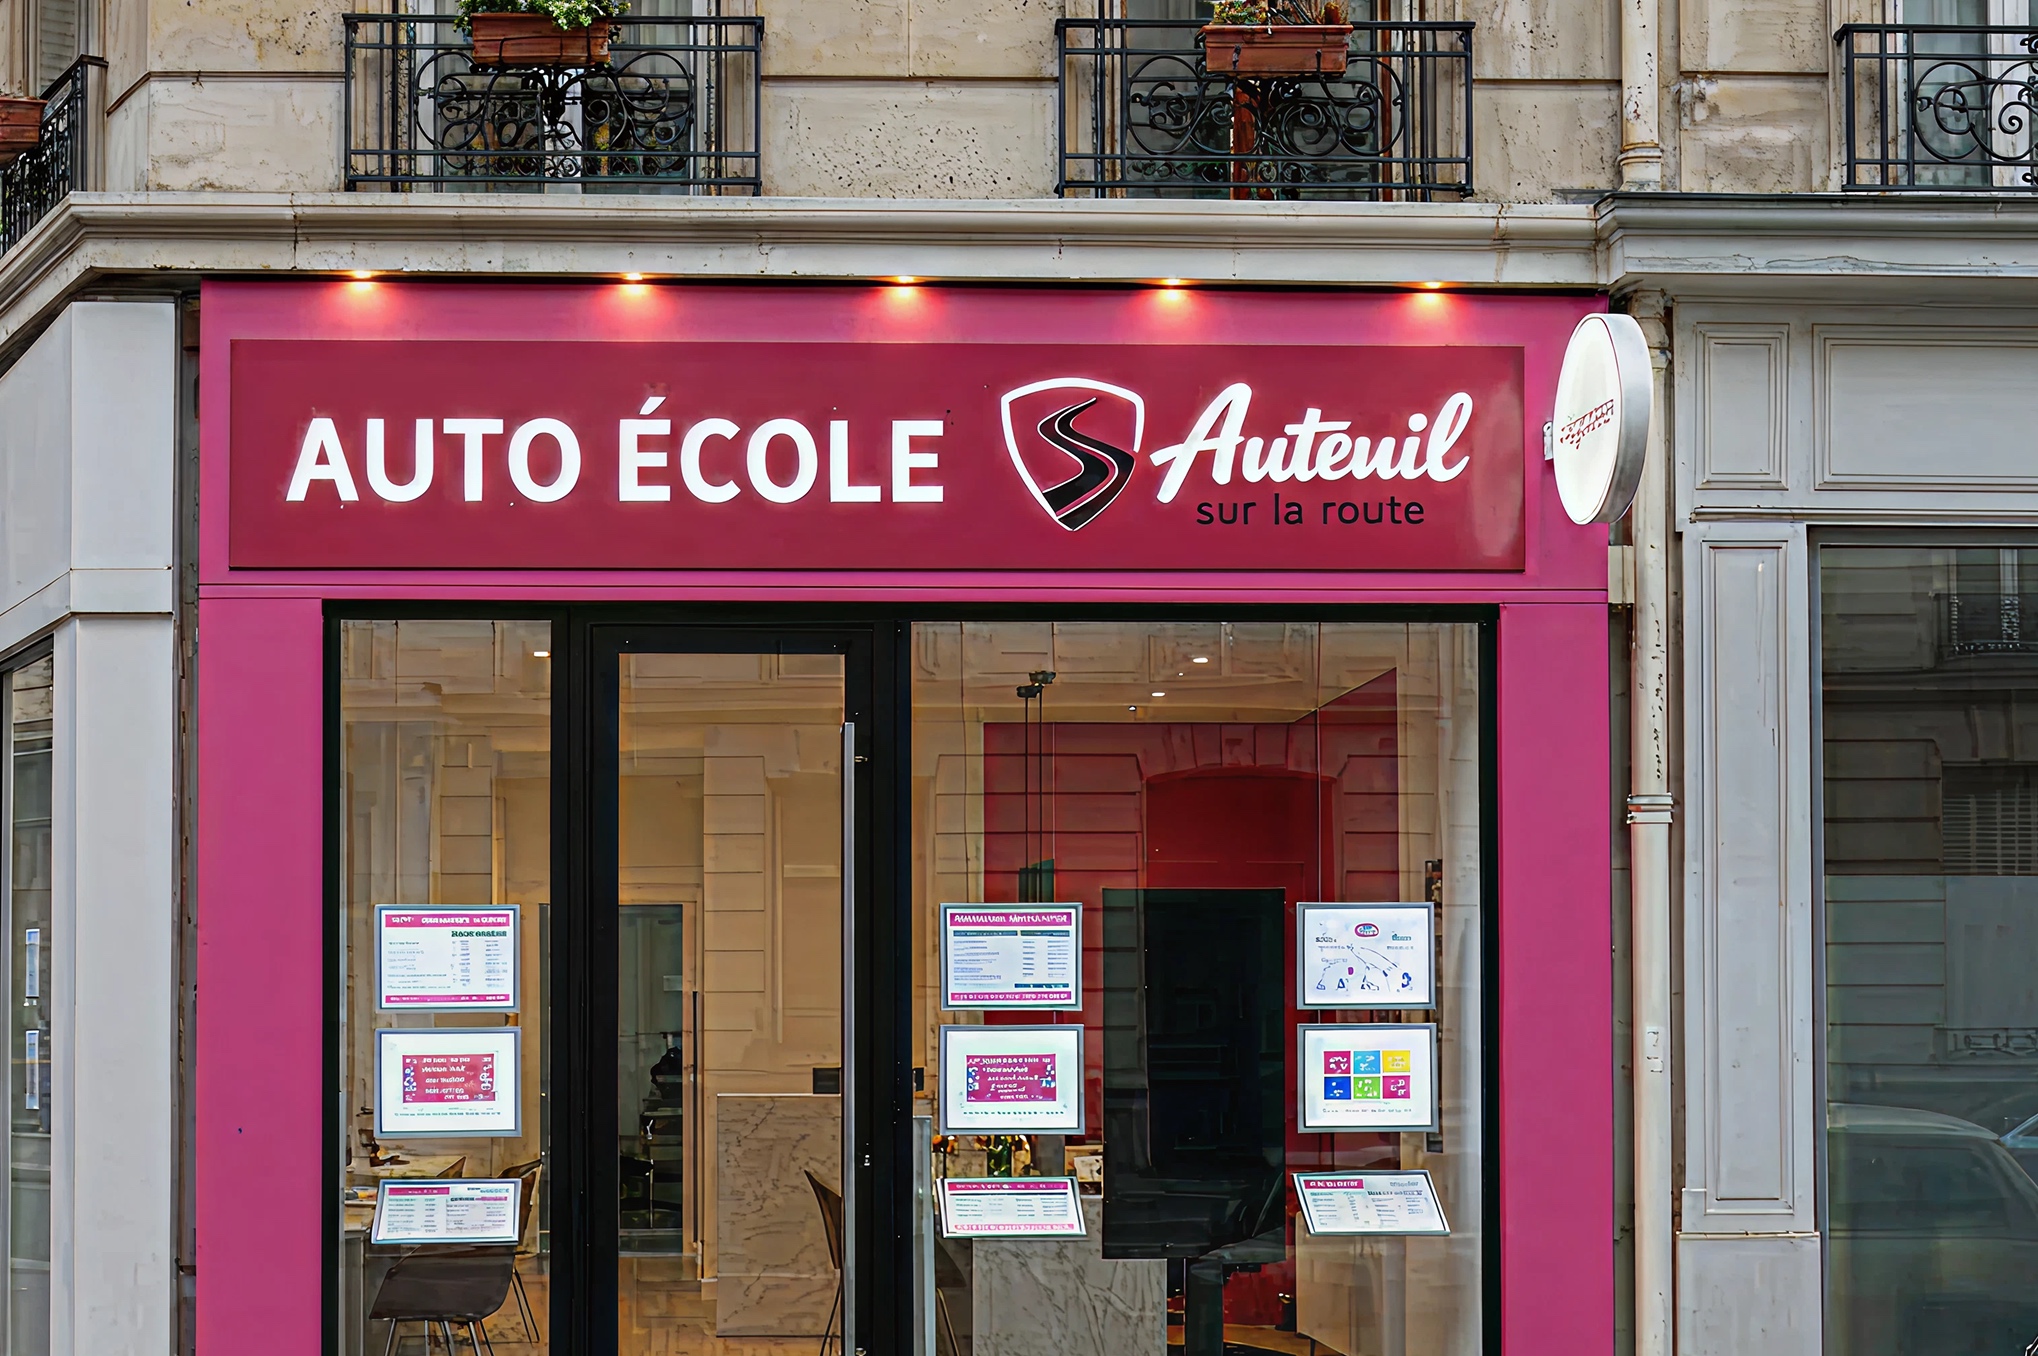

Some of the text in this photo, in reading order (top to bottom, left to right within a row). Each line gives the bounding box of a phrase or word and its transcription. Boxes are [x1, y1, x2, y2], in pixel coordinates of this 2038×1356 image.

[285, 396, 944, 504] AUTO ÉCOLE
[1150, 382, 1474, 504] Auteuil
[1196, 492, 1426, 526] sur la route
